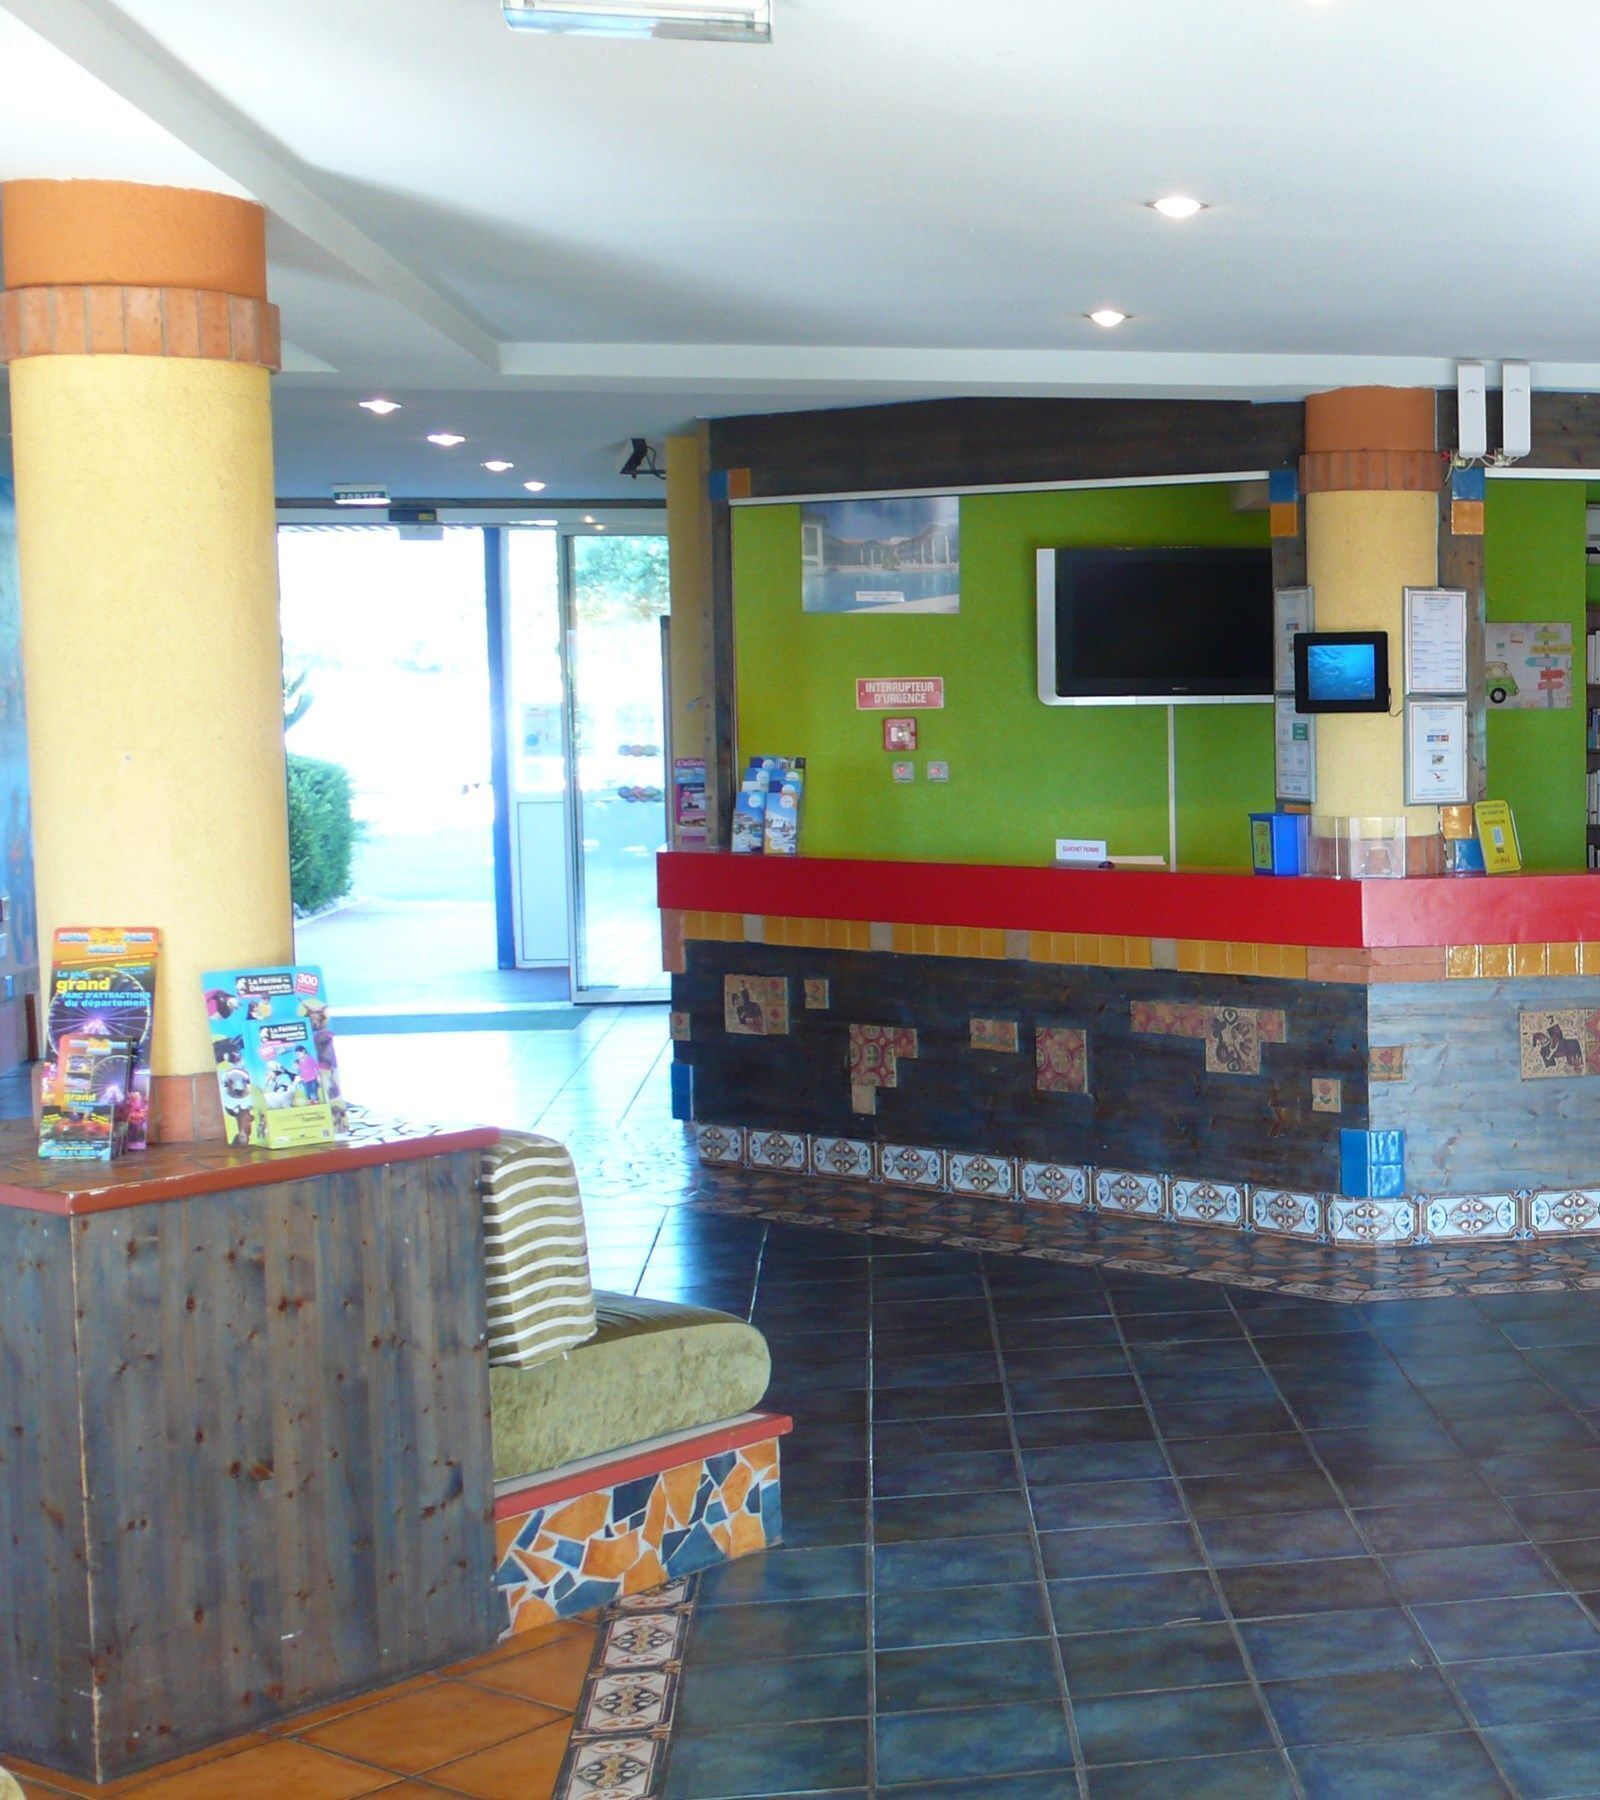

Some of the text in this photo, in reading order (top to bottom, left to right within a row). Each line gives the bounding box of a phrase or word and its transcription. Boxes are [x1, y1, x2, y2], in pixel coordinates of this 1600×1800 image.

[865, 682, 934, 692] INTERRUPTEUR
[874, 693, 927, 703] D'URGENCE
[298, 973, 318, 986] 300
[56, 977, 111, 993] grand
[81, 999, 151, 1008] département
